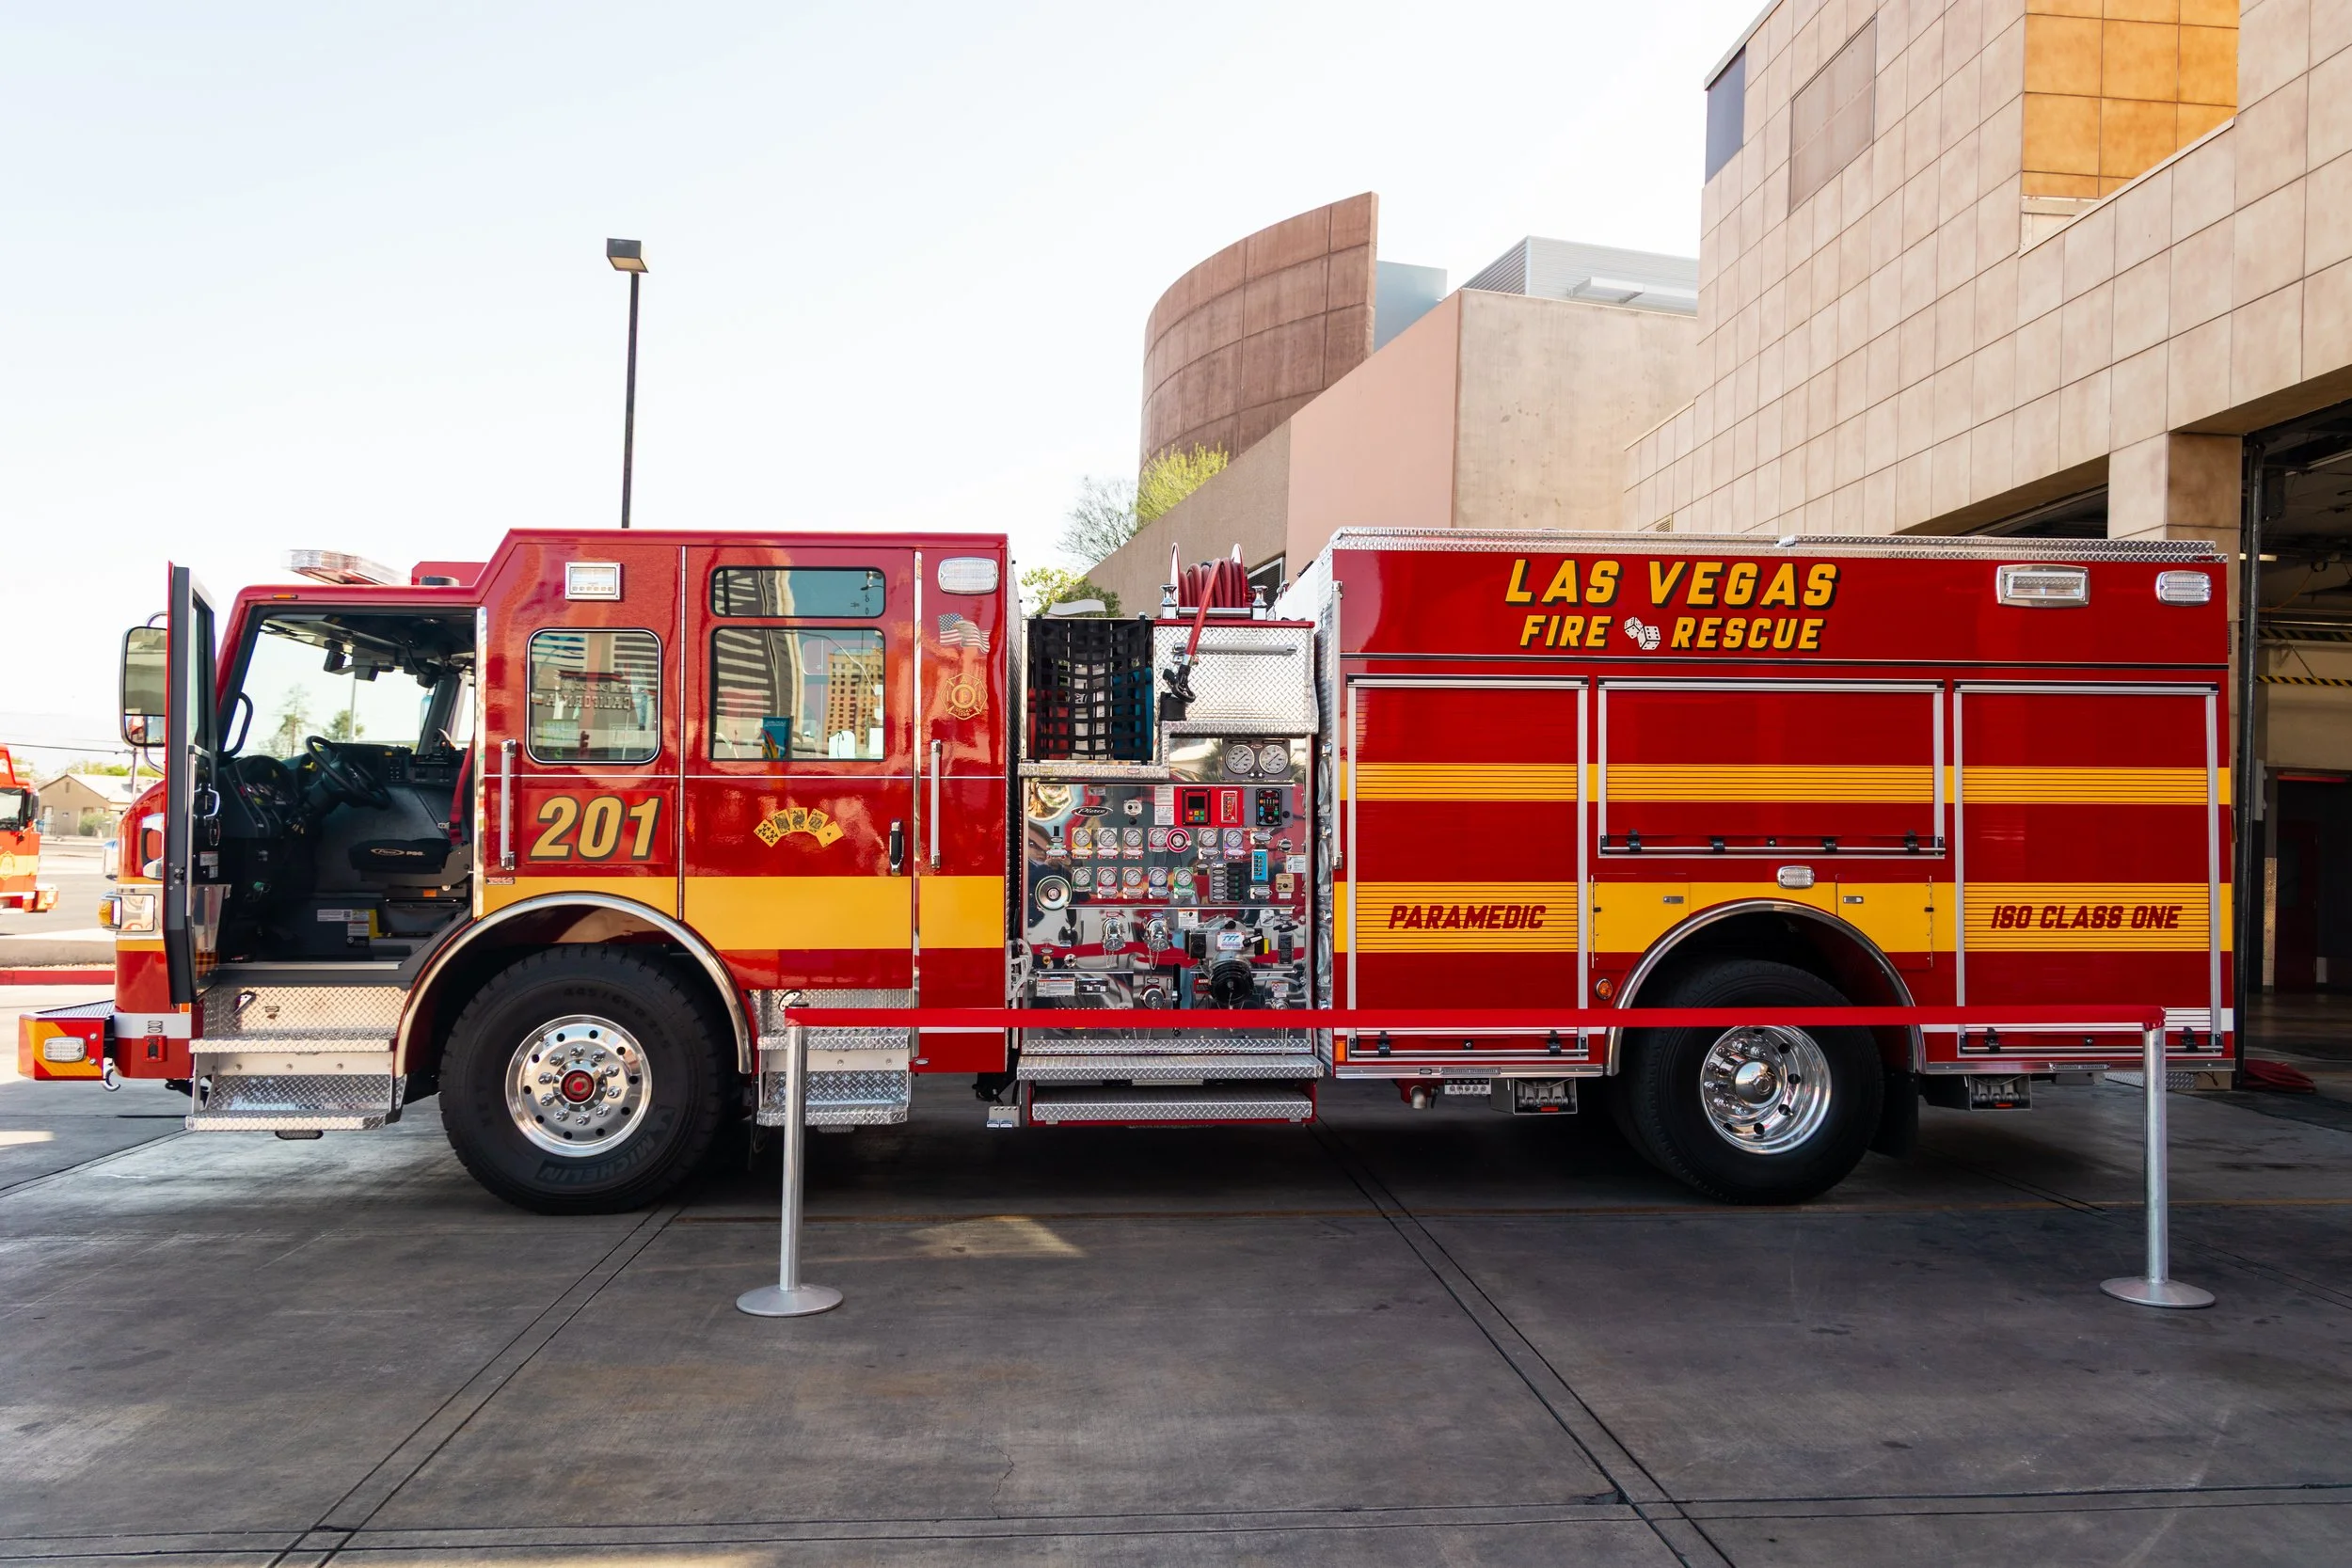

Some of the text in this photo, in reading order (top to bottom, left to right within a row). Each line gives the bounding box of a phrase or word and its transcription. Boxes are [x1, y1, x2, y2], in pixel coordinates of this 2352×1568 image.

[1505, 559, 1839, 609] LAS VEGAS
[1519, 615, 1826, 650] FIRE RESCUE
[530, 796, 662, 860] 201
[1388, 905, 1547, 929] PARAMEDIC
[1991, 905, 2183, 928] ISO CLASS ONE
[539, 1133, 656, 1181] MICHELIN
